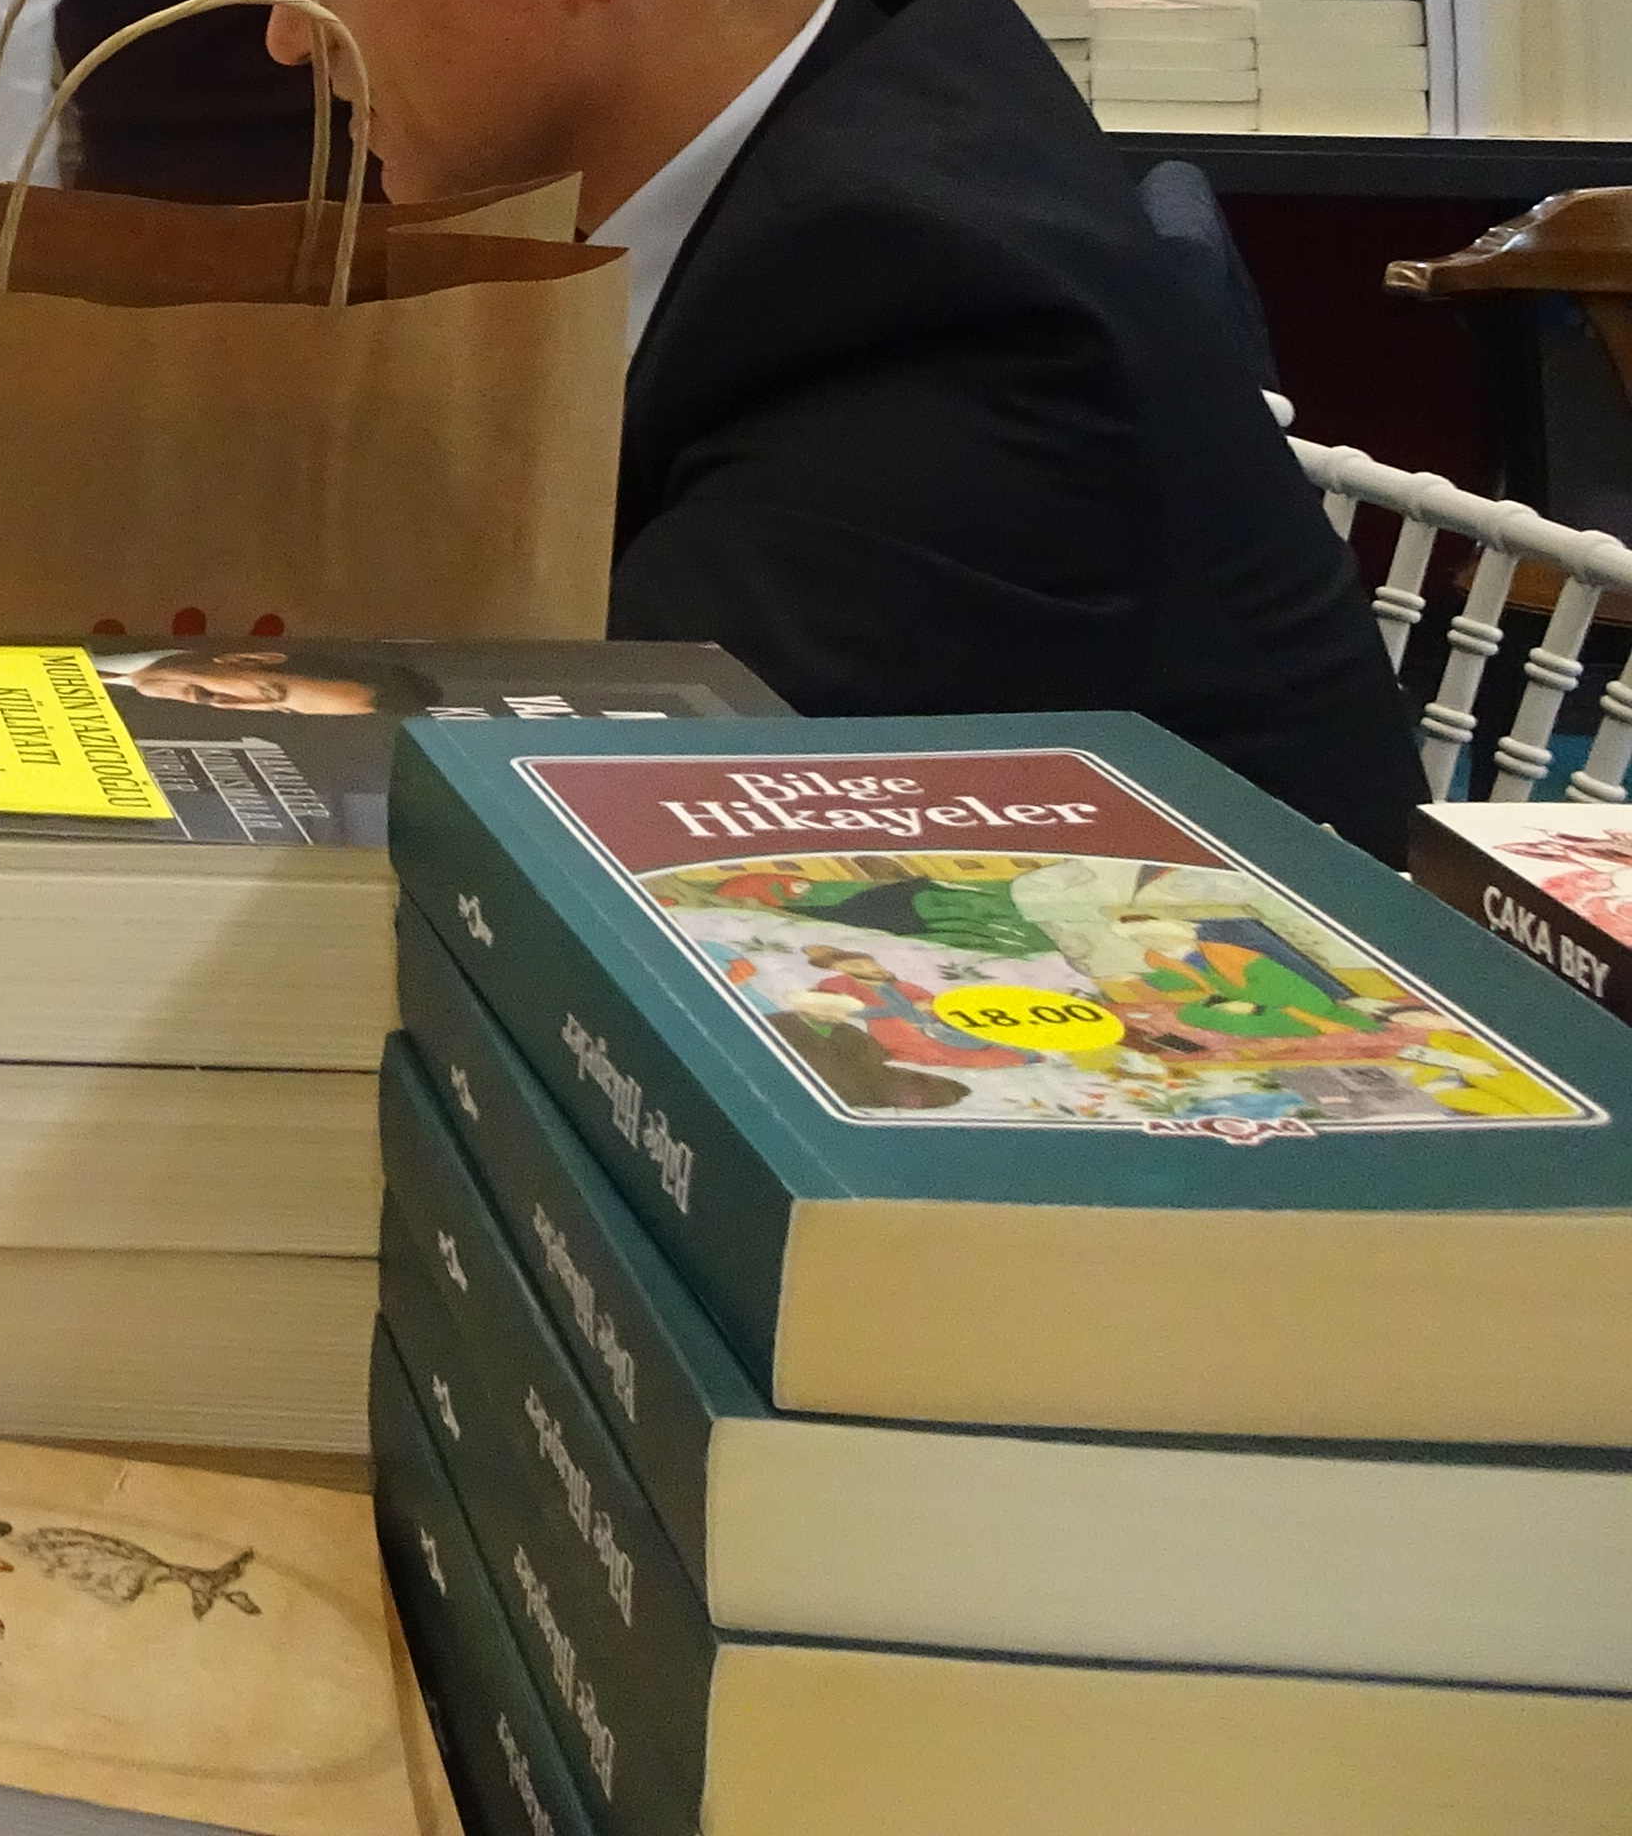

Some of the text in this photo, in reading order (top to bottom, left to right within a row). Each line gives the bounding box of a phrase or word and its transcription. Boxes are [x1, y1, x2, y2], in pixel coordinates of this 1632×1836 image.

[41, 654, 152, 810] MUHSİN YAZICIOĞLU
[725, 770, 925, 809] Bilge
[660, 792, 1101, 841] Hikayeler
[1483, 883, 1612, 1003] ÇAKA BEY
[949, 996, 1105, 1035] 18.00
